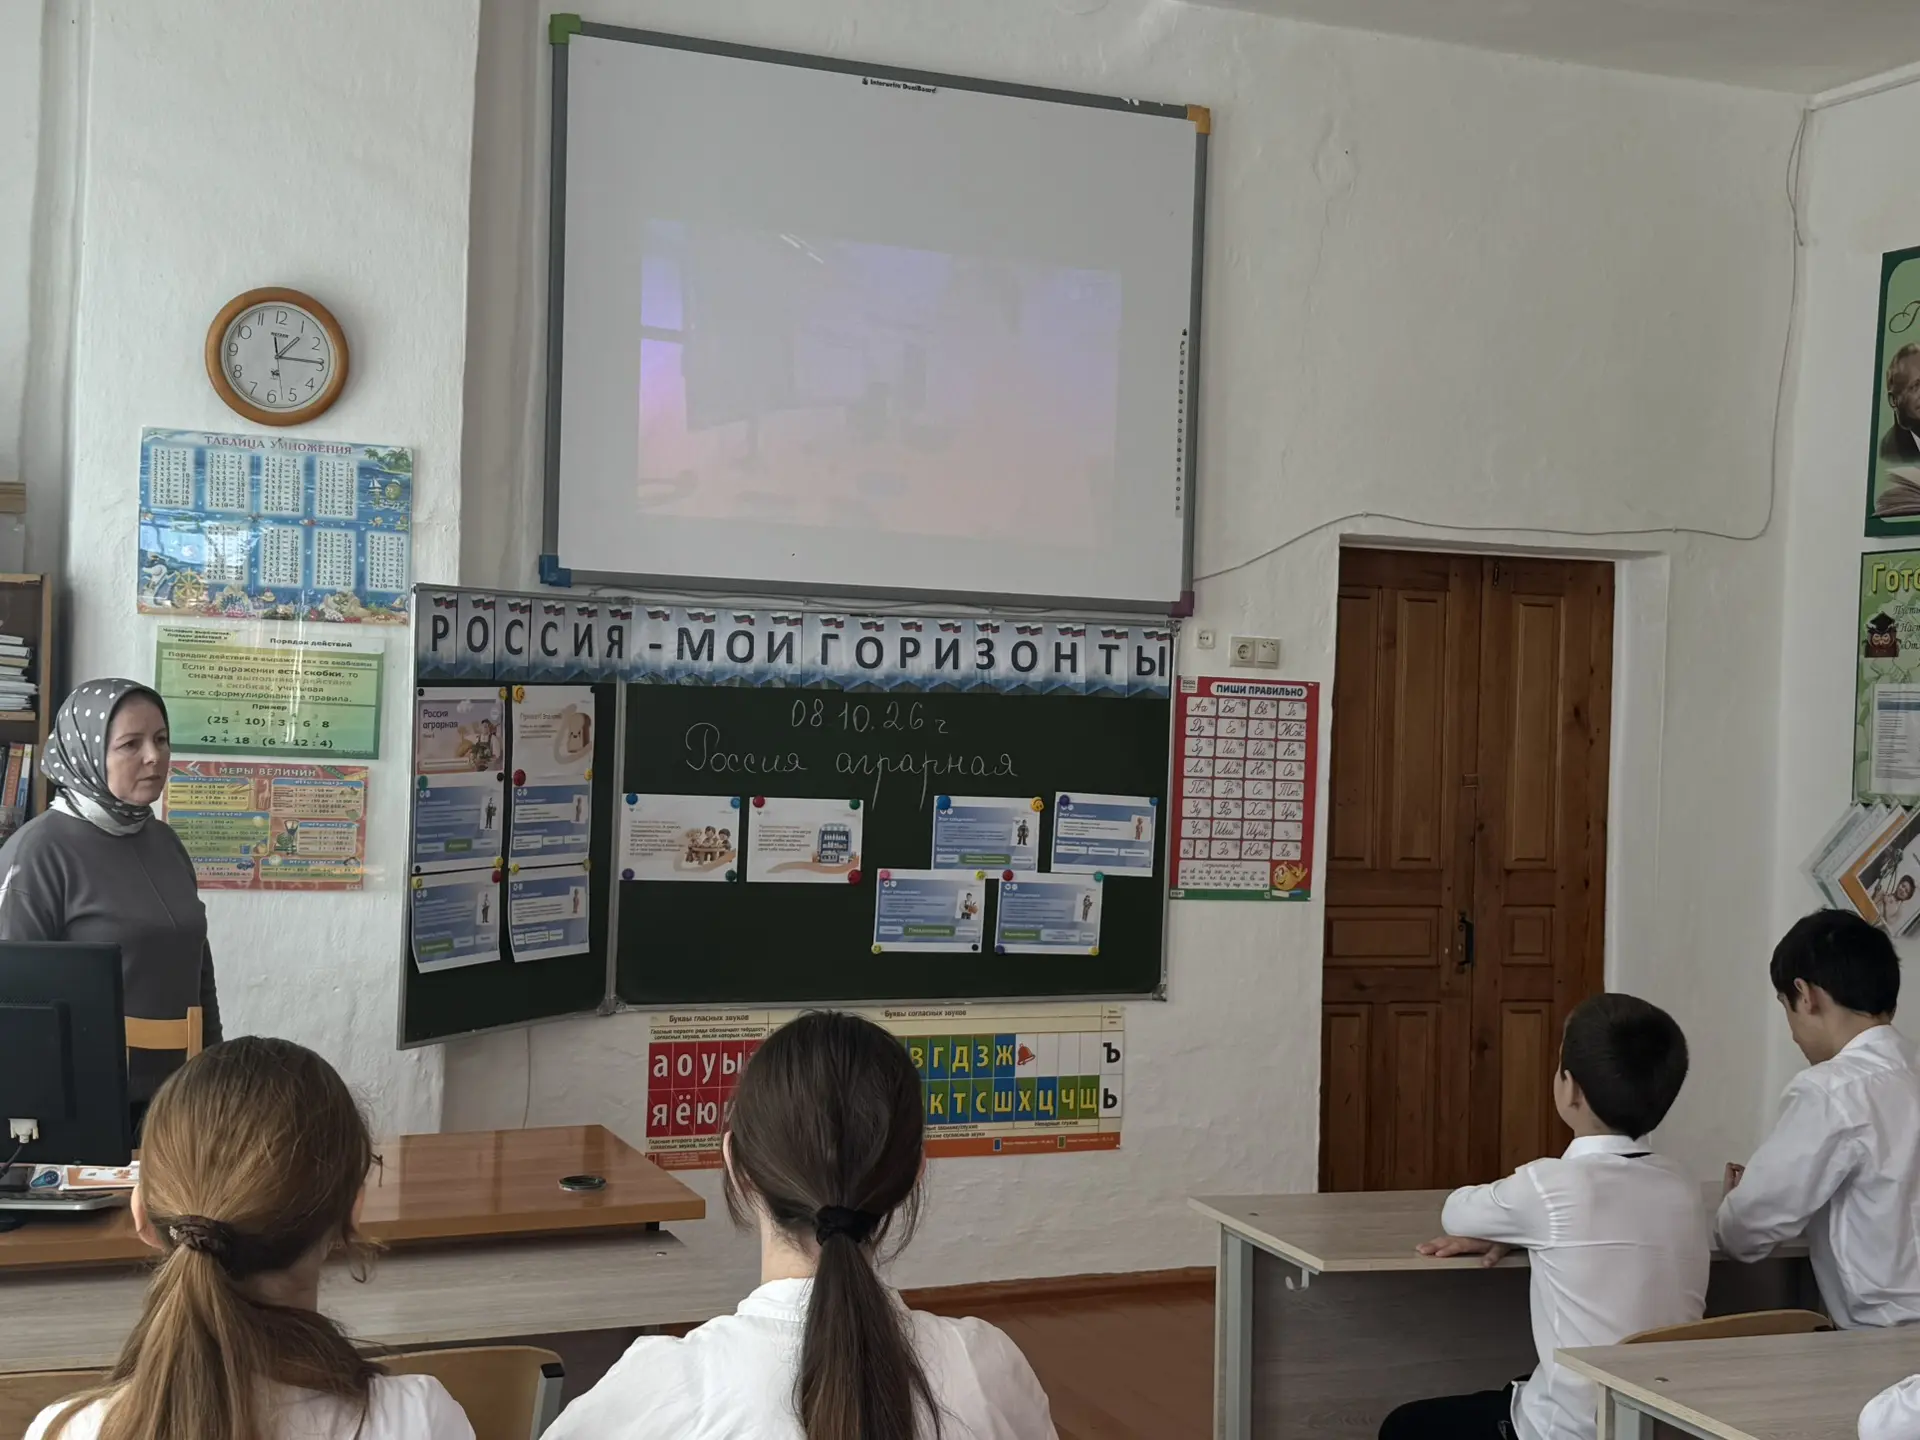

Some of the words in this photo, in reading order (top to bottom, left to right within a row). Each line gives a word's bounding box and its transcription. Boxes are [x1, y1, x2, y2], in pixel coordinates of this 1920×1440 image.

[257, 312, 264, 326] 11
[276, 310, 288, 325] 12
[237, 325, 252, 339] 10
[229, 342, 239, 357] 9
[311, 336, 321, 351] 2
[232, 364, 242, 379] 8
[315, 358, 325, 372] 3
[249, 381, 258, 395] 7
[305, 377, 314, 390] 4
[266, 389, 277, 404] 6
[288, 388, 297, 402] 5
[204, 436, 265, 449] ТАБЛИЦА
[270, 439, 352, 455] УМНОЖЕНИЯ
[270, 637, 309, 645] Порядок
[311, 640, 352, 648] действий
[432, 614, 624, 659] РОССИЯ
[677, 627, 793, 664] МОИ
[821, 633, 1165, 677] ГОРИЗОНТЫ
[168, 651, 207, 660] Порядок
[182, 663, 205, 671] Если
[218, 665, 274, 674] выражении
[188, 672, 233, 680] сначала
[186, 689, 205, 697] уже
[1217, 684, 1247, 693] ПИШИ
[1248, 686, 1303, 697] ПРАВИЛЬНО
[423, 709, 448, 718] Россия
[1191, 698, 1208, 712] Аа
[1222, 698, 1240, 714] Бб
[1254, 701, 1268, 715] Вв
[207, 715, 229, 725] (25
[245, 717, 266, 727] 10)
[422, 721, 458, 731] аграрная
[1190, 718, 1205, 736] Дд
[1278, 722, 1304, 736] Жж
[201, 735, 217, 743] 42
[262, 737, 276, 747] (6
[293, 739, 309, 747] 12
[320, 740, 333, 749] 4)
[1223, 740, 1237, 754] Ии
[219, 767, 254, 775] МЕРЫ
[258, 768, 317, 777] ВЕЛИЧИН
[685, 722, 808, 773] Россия
[836, 749, 1018, 811] аграрная
[1217, 761, 1240, 775] Мм
[1250, 761, 1266, 775] Нн
[1188, 779, 1206, 794] Пп
[1247, 802, 1266, 816] Хх
[1214, 821, 1235, 835] Шш
[669, 1015, 692, 1023] Буквы
[725, 1014, 749, 1022] звуков
[884, 1010, 906, 1019] Буквы
[653, 1054, 668, 1078] а
[677, 1053, 693, 1077] о
[701, 1052, 716, 1084] у
[722, 1052, 742, 1075] ы
[651, 1103, 667, 1127] я
[676, 1094, 691, 1125] ё
[696, 1102, 717, 1125] ю
